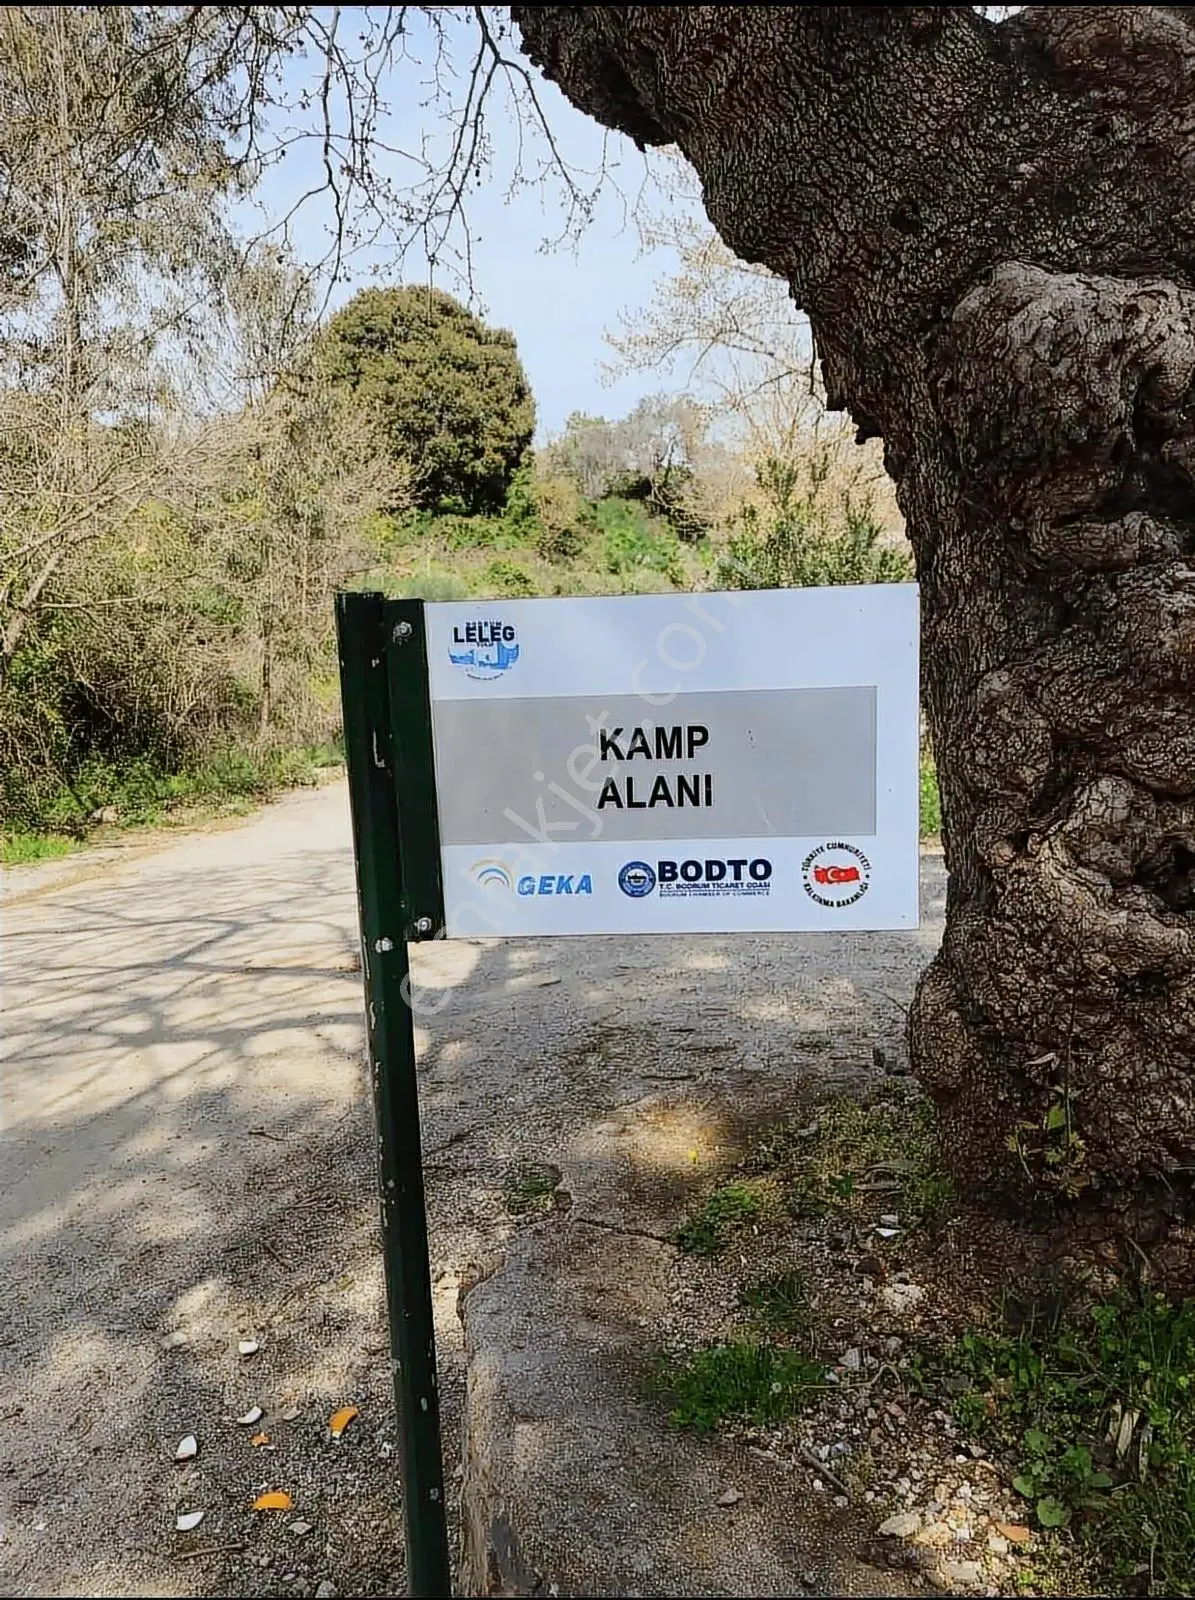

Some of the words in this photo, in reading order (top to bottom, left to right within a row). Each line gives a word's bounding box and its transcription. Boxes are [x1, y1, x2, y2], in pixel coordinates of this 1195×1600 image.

[453, 625, 515, 643] LELEG
[599, 725, 710, 761] KAMP
[597, 774, 713, 809] ALANI
[657, 858, 773, 883] BODTO
[516, 874, 593, 896] GEKA
